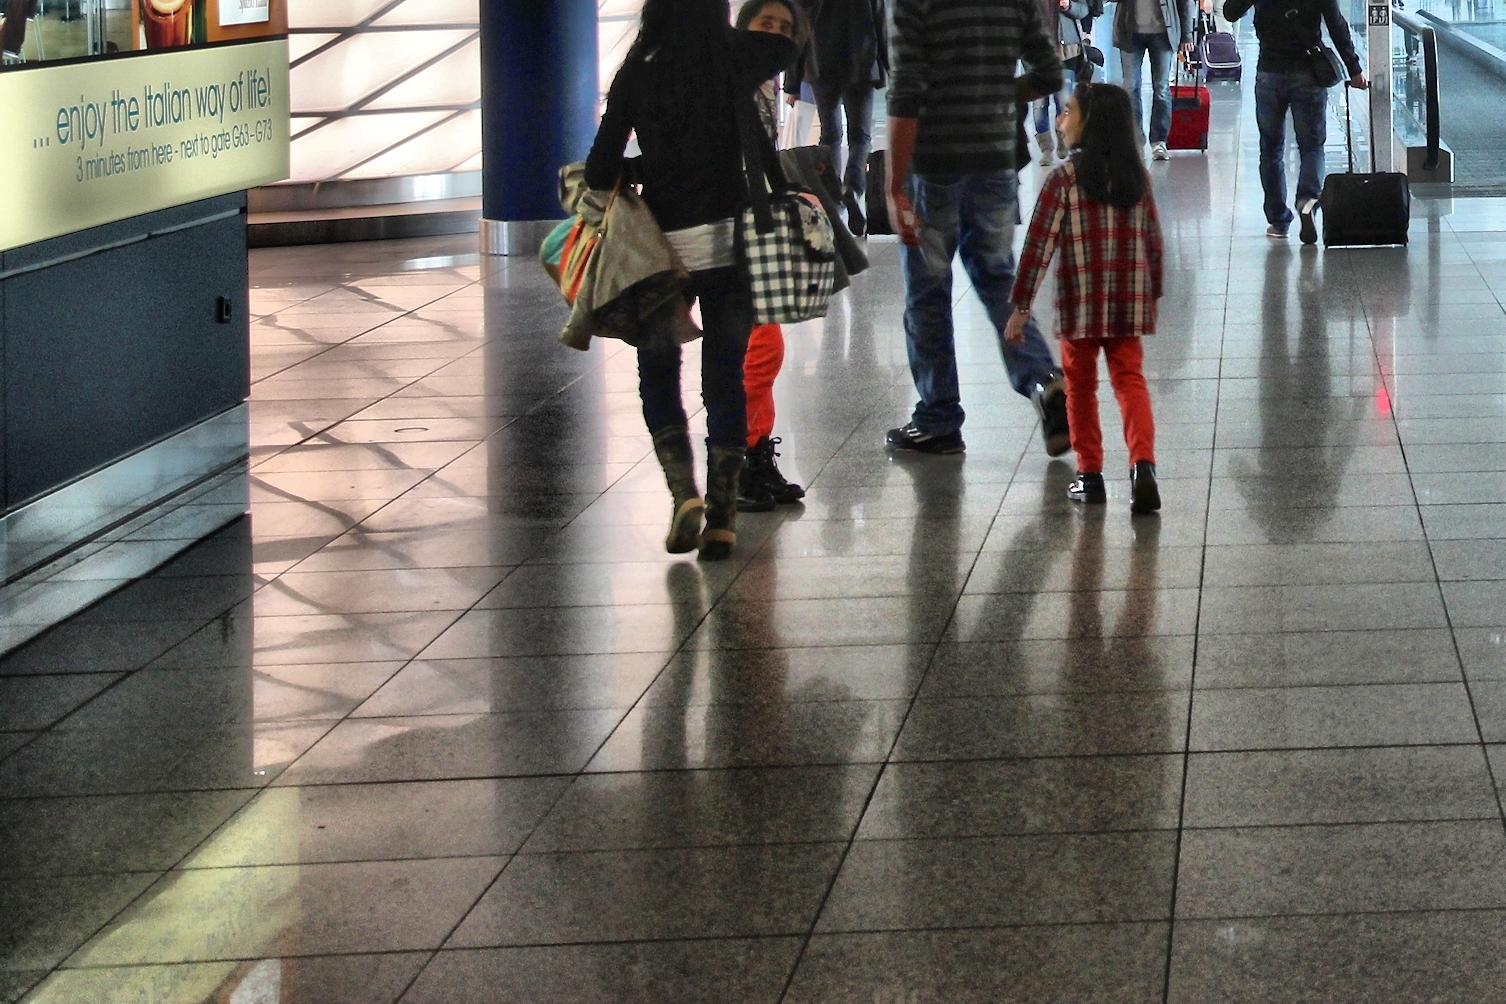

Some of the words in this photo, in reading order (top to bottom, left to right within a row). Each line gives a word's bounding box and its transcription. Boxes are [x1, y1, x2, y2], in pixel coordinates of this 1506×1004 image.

[56, 95, 107, 150] enjoy
[111, 90, 140, 134] the
[144, 82, 192, 128] Italian
[195, 83, 226, 123] way
[229, 71, 244, 112] of
[247, 68, 271, 110] life!
[76, 156, 83, 182] 3
[86, 152, 126, 181] minutes
[127, 148, 150, 172] from
[152, 142, 173, 167] here
[180, 134, 199, 158] next
[200, 132, 210, 151] to
[211, 128, 231, 160] gate
